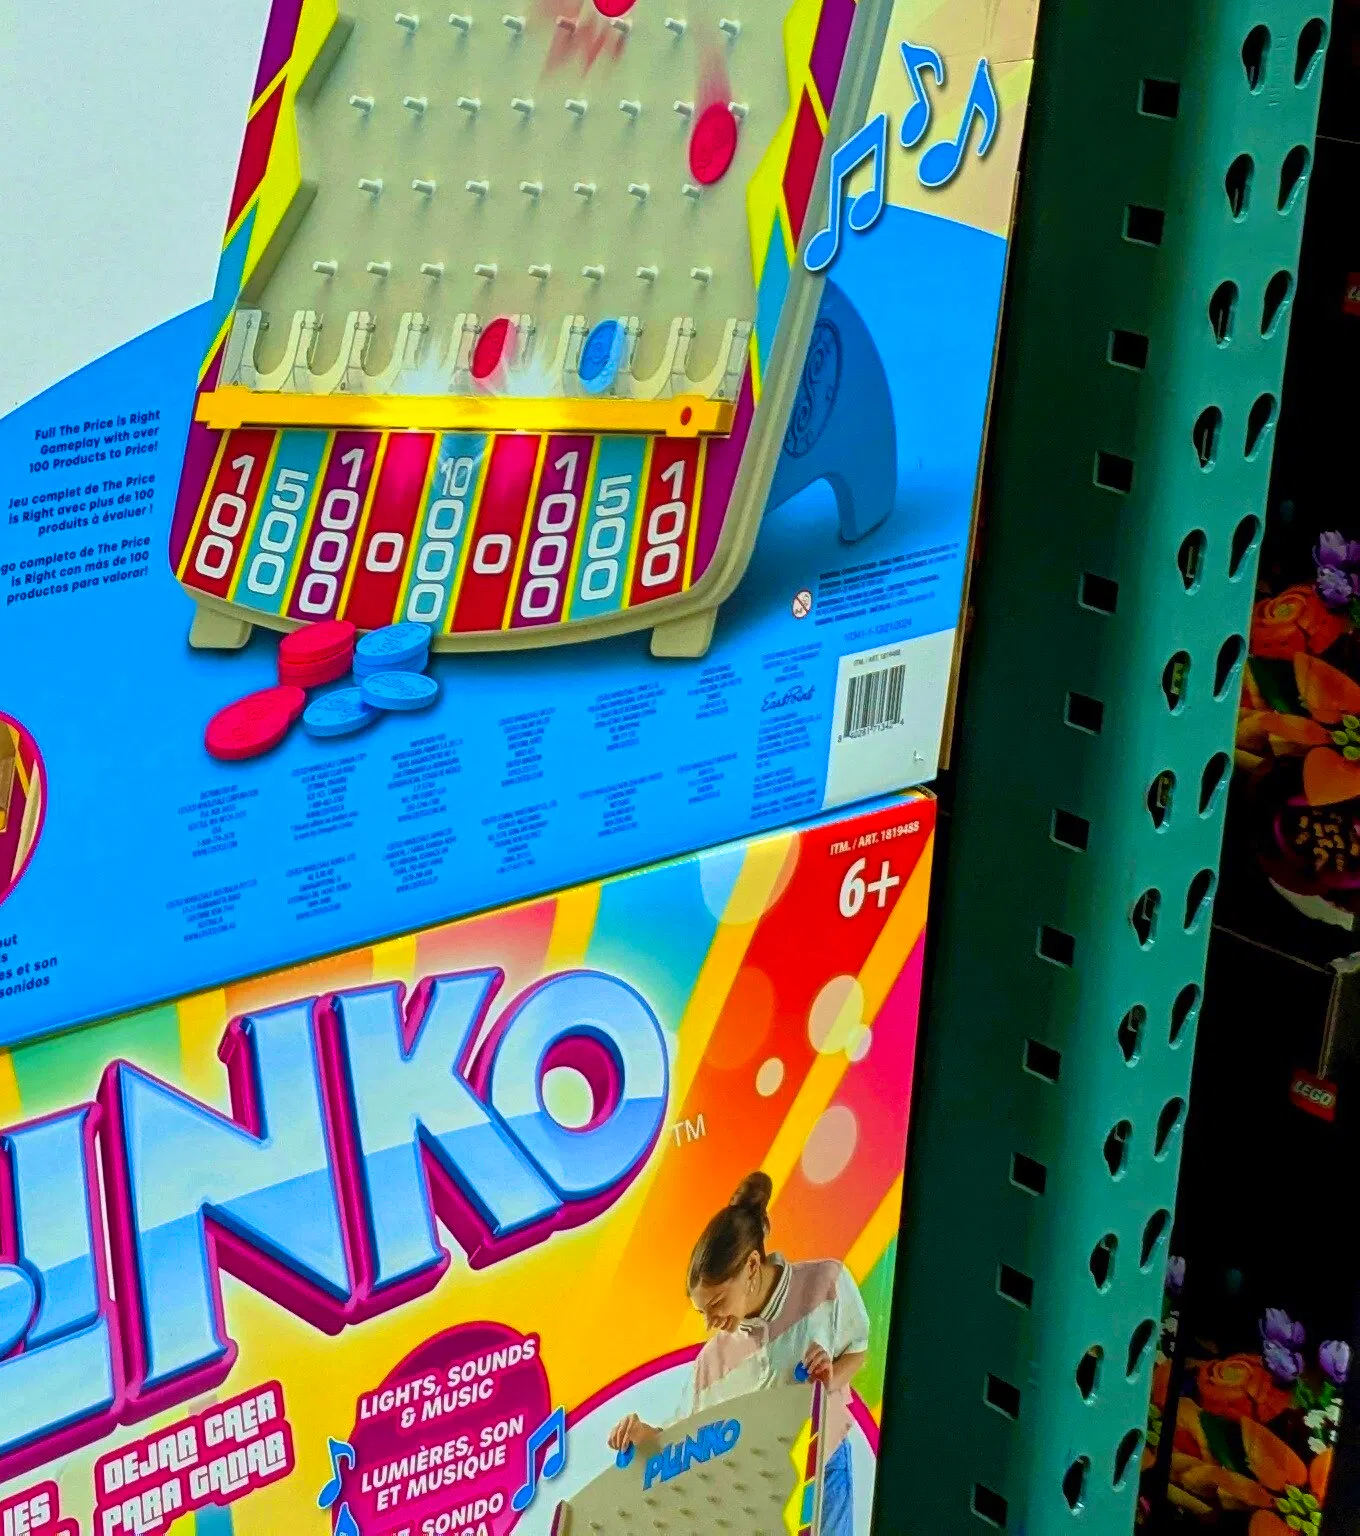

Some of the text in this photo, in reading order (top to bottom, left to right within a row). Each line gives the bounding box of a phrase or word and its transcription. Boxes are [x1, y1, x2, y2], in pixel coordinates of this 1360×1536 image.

[35, 409, 160, 441] Full The Price is Right
[40, 427, 159, 456] Gameplay with over
[29, 441, 158, 473] 100 Products to Price!
[839, 857, 899, 917] 6+
[16, 963, 31, 976] et
[33, 955, 58, 972] son
[360, 1339, 536, 1419] LIGHTS, SOUNDS
[401, 1378, 494, 1428] & MUSIC
[103, 1390, 278, 1495] DEJAR CAER
[361, 1414, 524, 1493] LUMIÈRES, SON
[642, 1417, 742, 1491] PLINKO
[102, 1430, 286, 1536] PARA GANAR
[377, 1445, 507, 1511] ET MUSIQUE
[422, 1492, 504, 1536] SONIDO
